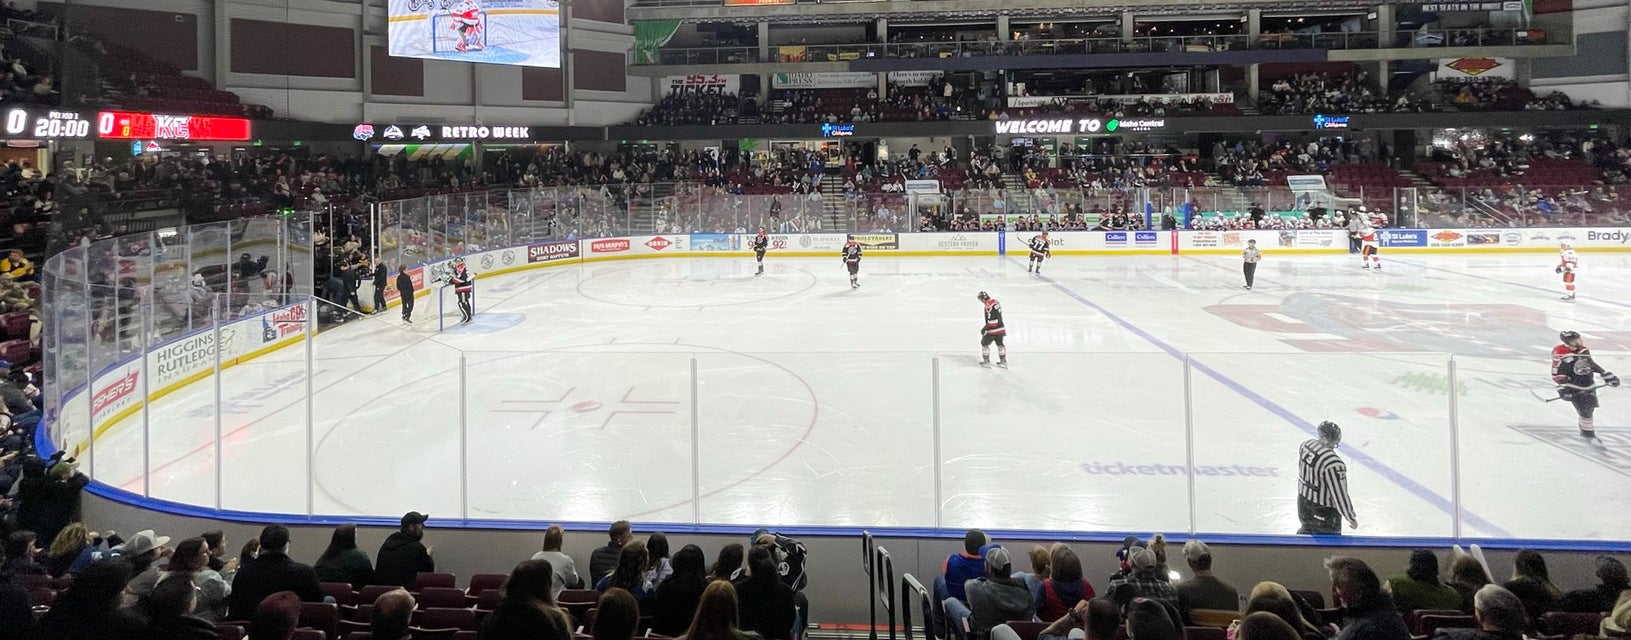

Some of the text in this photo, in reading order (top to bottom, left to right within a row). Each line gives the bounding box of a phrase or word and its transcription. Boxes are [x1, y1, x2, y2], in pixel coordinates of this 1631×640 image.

[6, 109, 27, 134] 0
[34, 118, 89, 137] 20:00
[99, 112, 114, 134] 0
[995, 119, 1101, 134] WELCOME TO
[1139, 119, 1165, 127] Central
[442, 126, 530, 139] RETRO WEEK
[1587, 230, 1629, 244] Brady
[530, 243, 577, 257] SHADOWS
[1033, 240, 1045, 250] 77
[272, 312, 290, 327] Idaho
[157, 333, 213, 363] HIGGINS
[1081, 462, 1280, 477] ticketmaster
